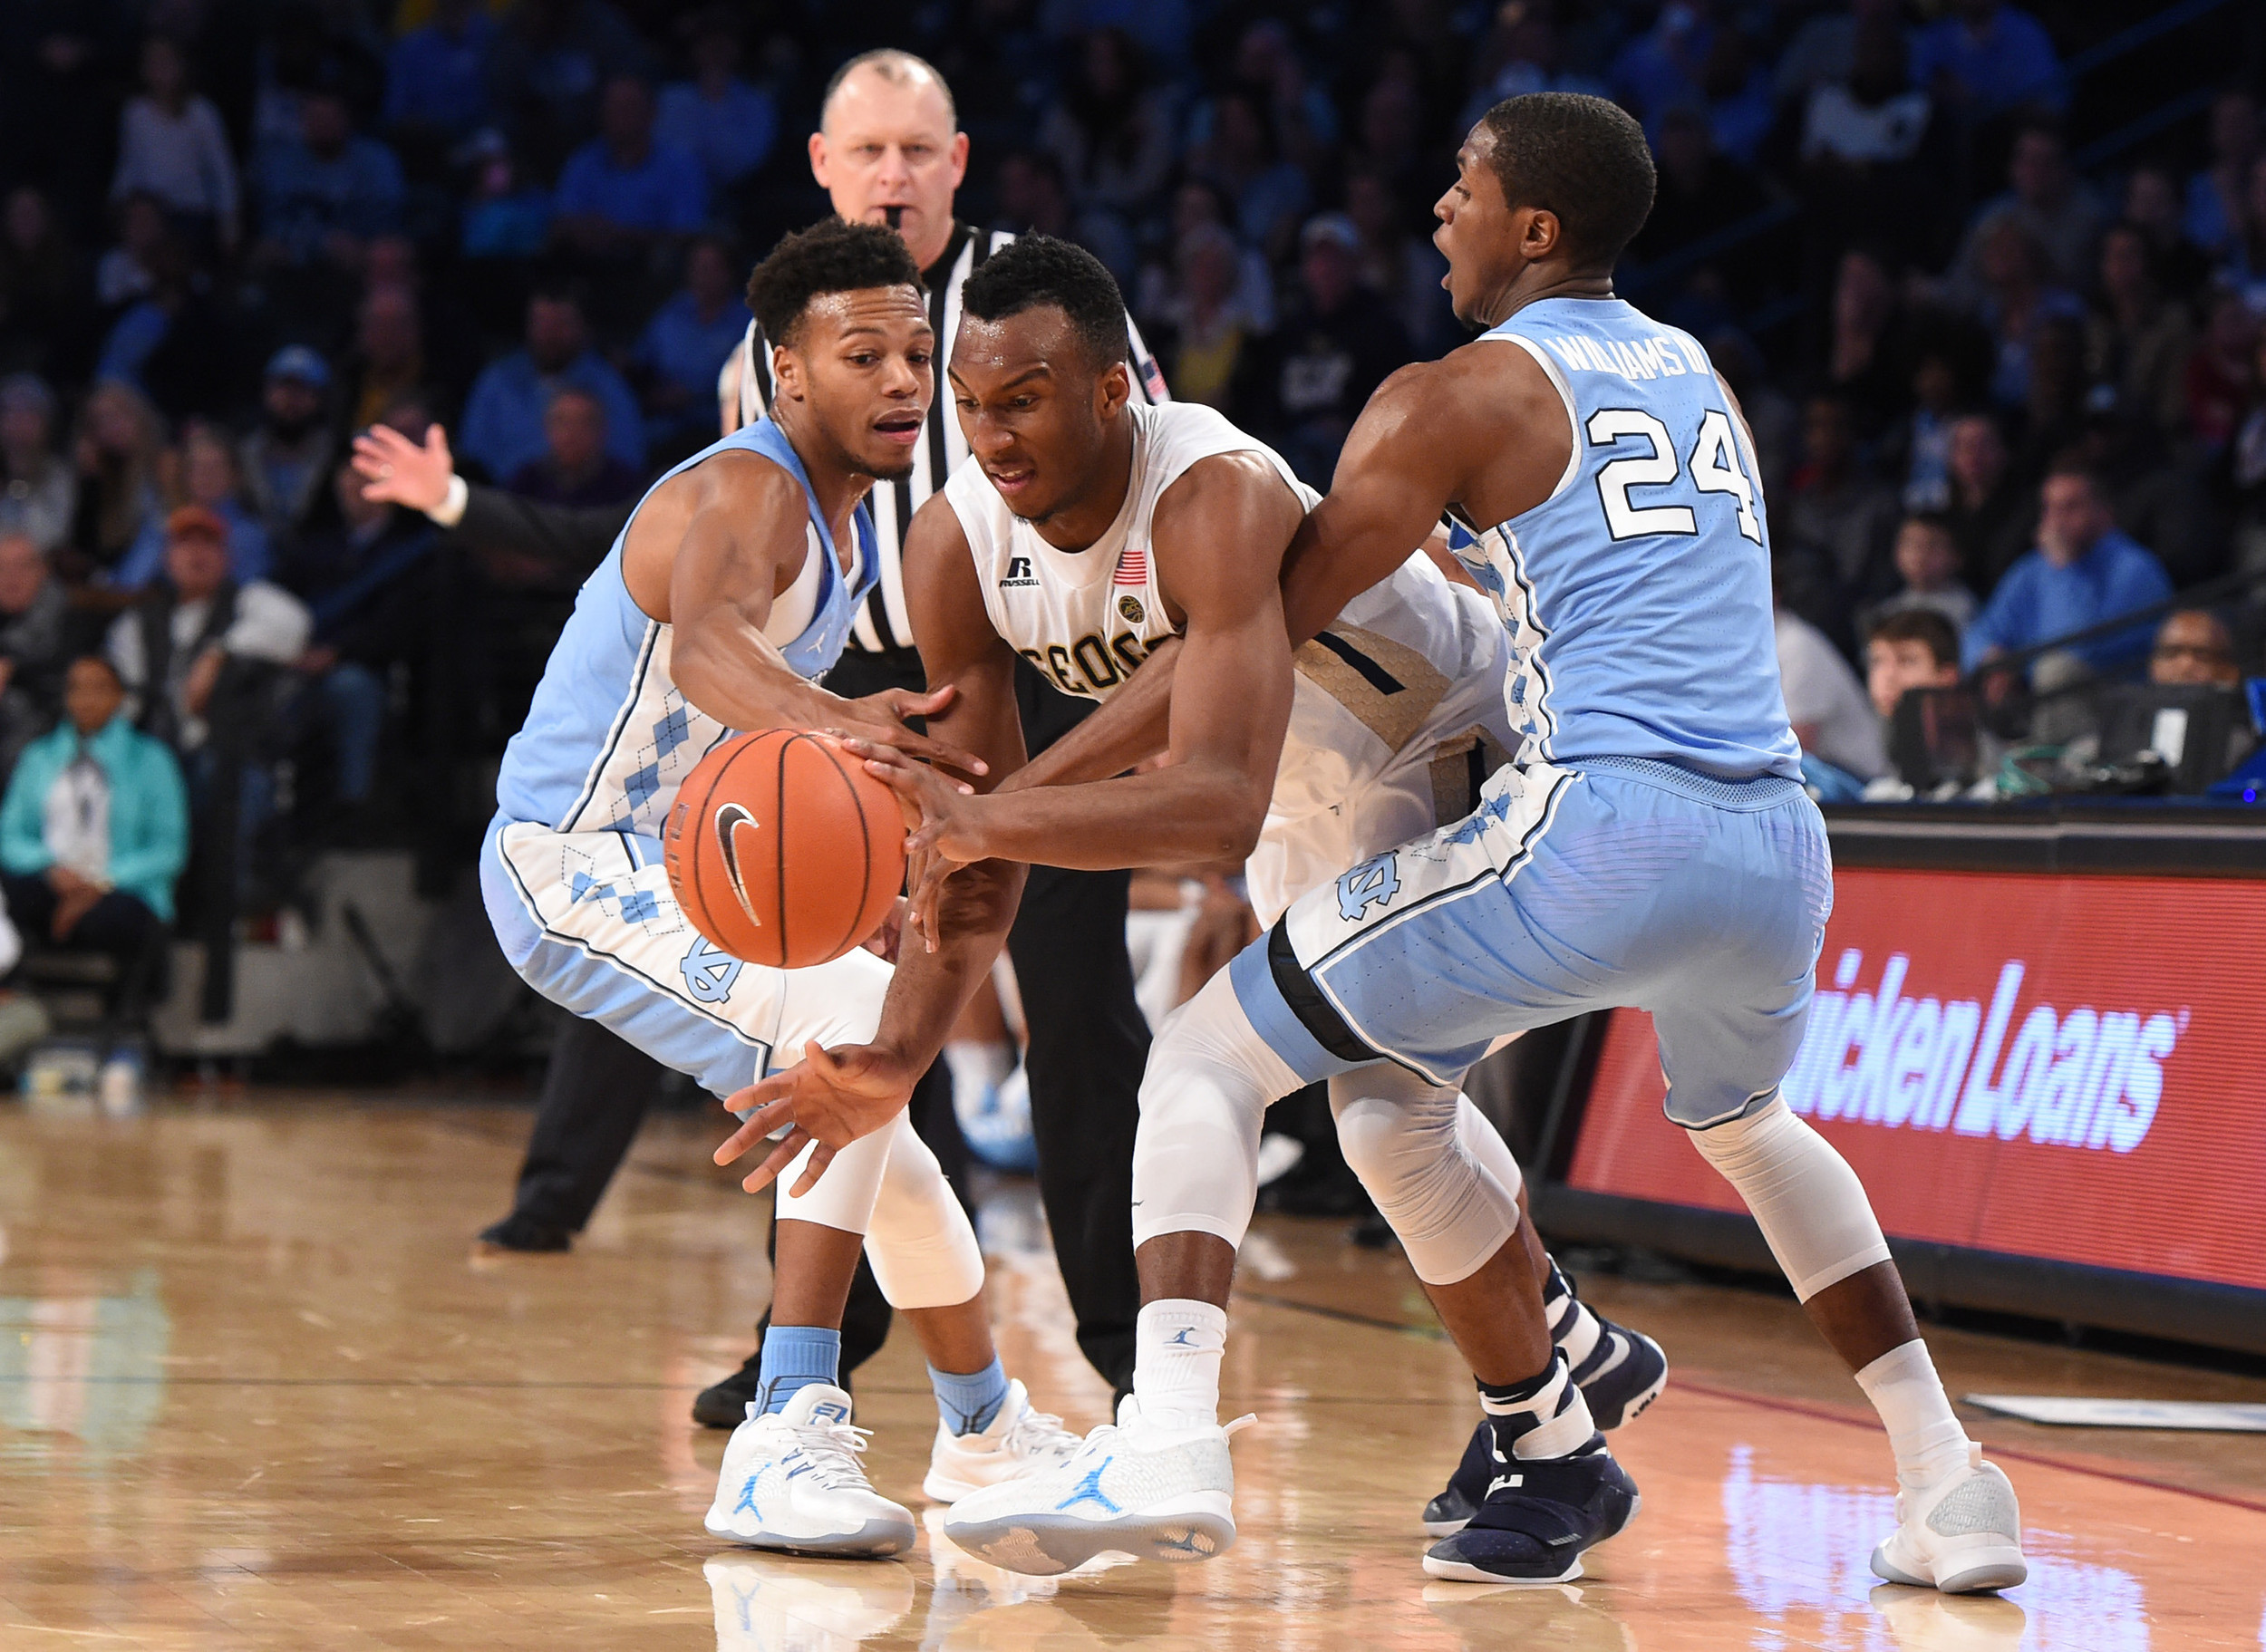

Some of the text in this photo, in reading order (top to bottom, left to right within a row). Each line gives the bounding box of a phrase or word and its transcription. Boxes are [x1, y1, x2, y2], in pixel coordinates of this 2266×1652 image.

[1543, 334, 1687, 381] WILLIAMS
[1585, 408, 1764, 547] 24
[999, 578, 1040, 588] RUSSELL
